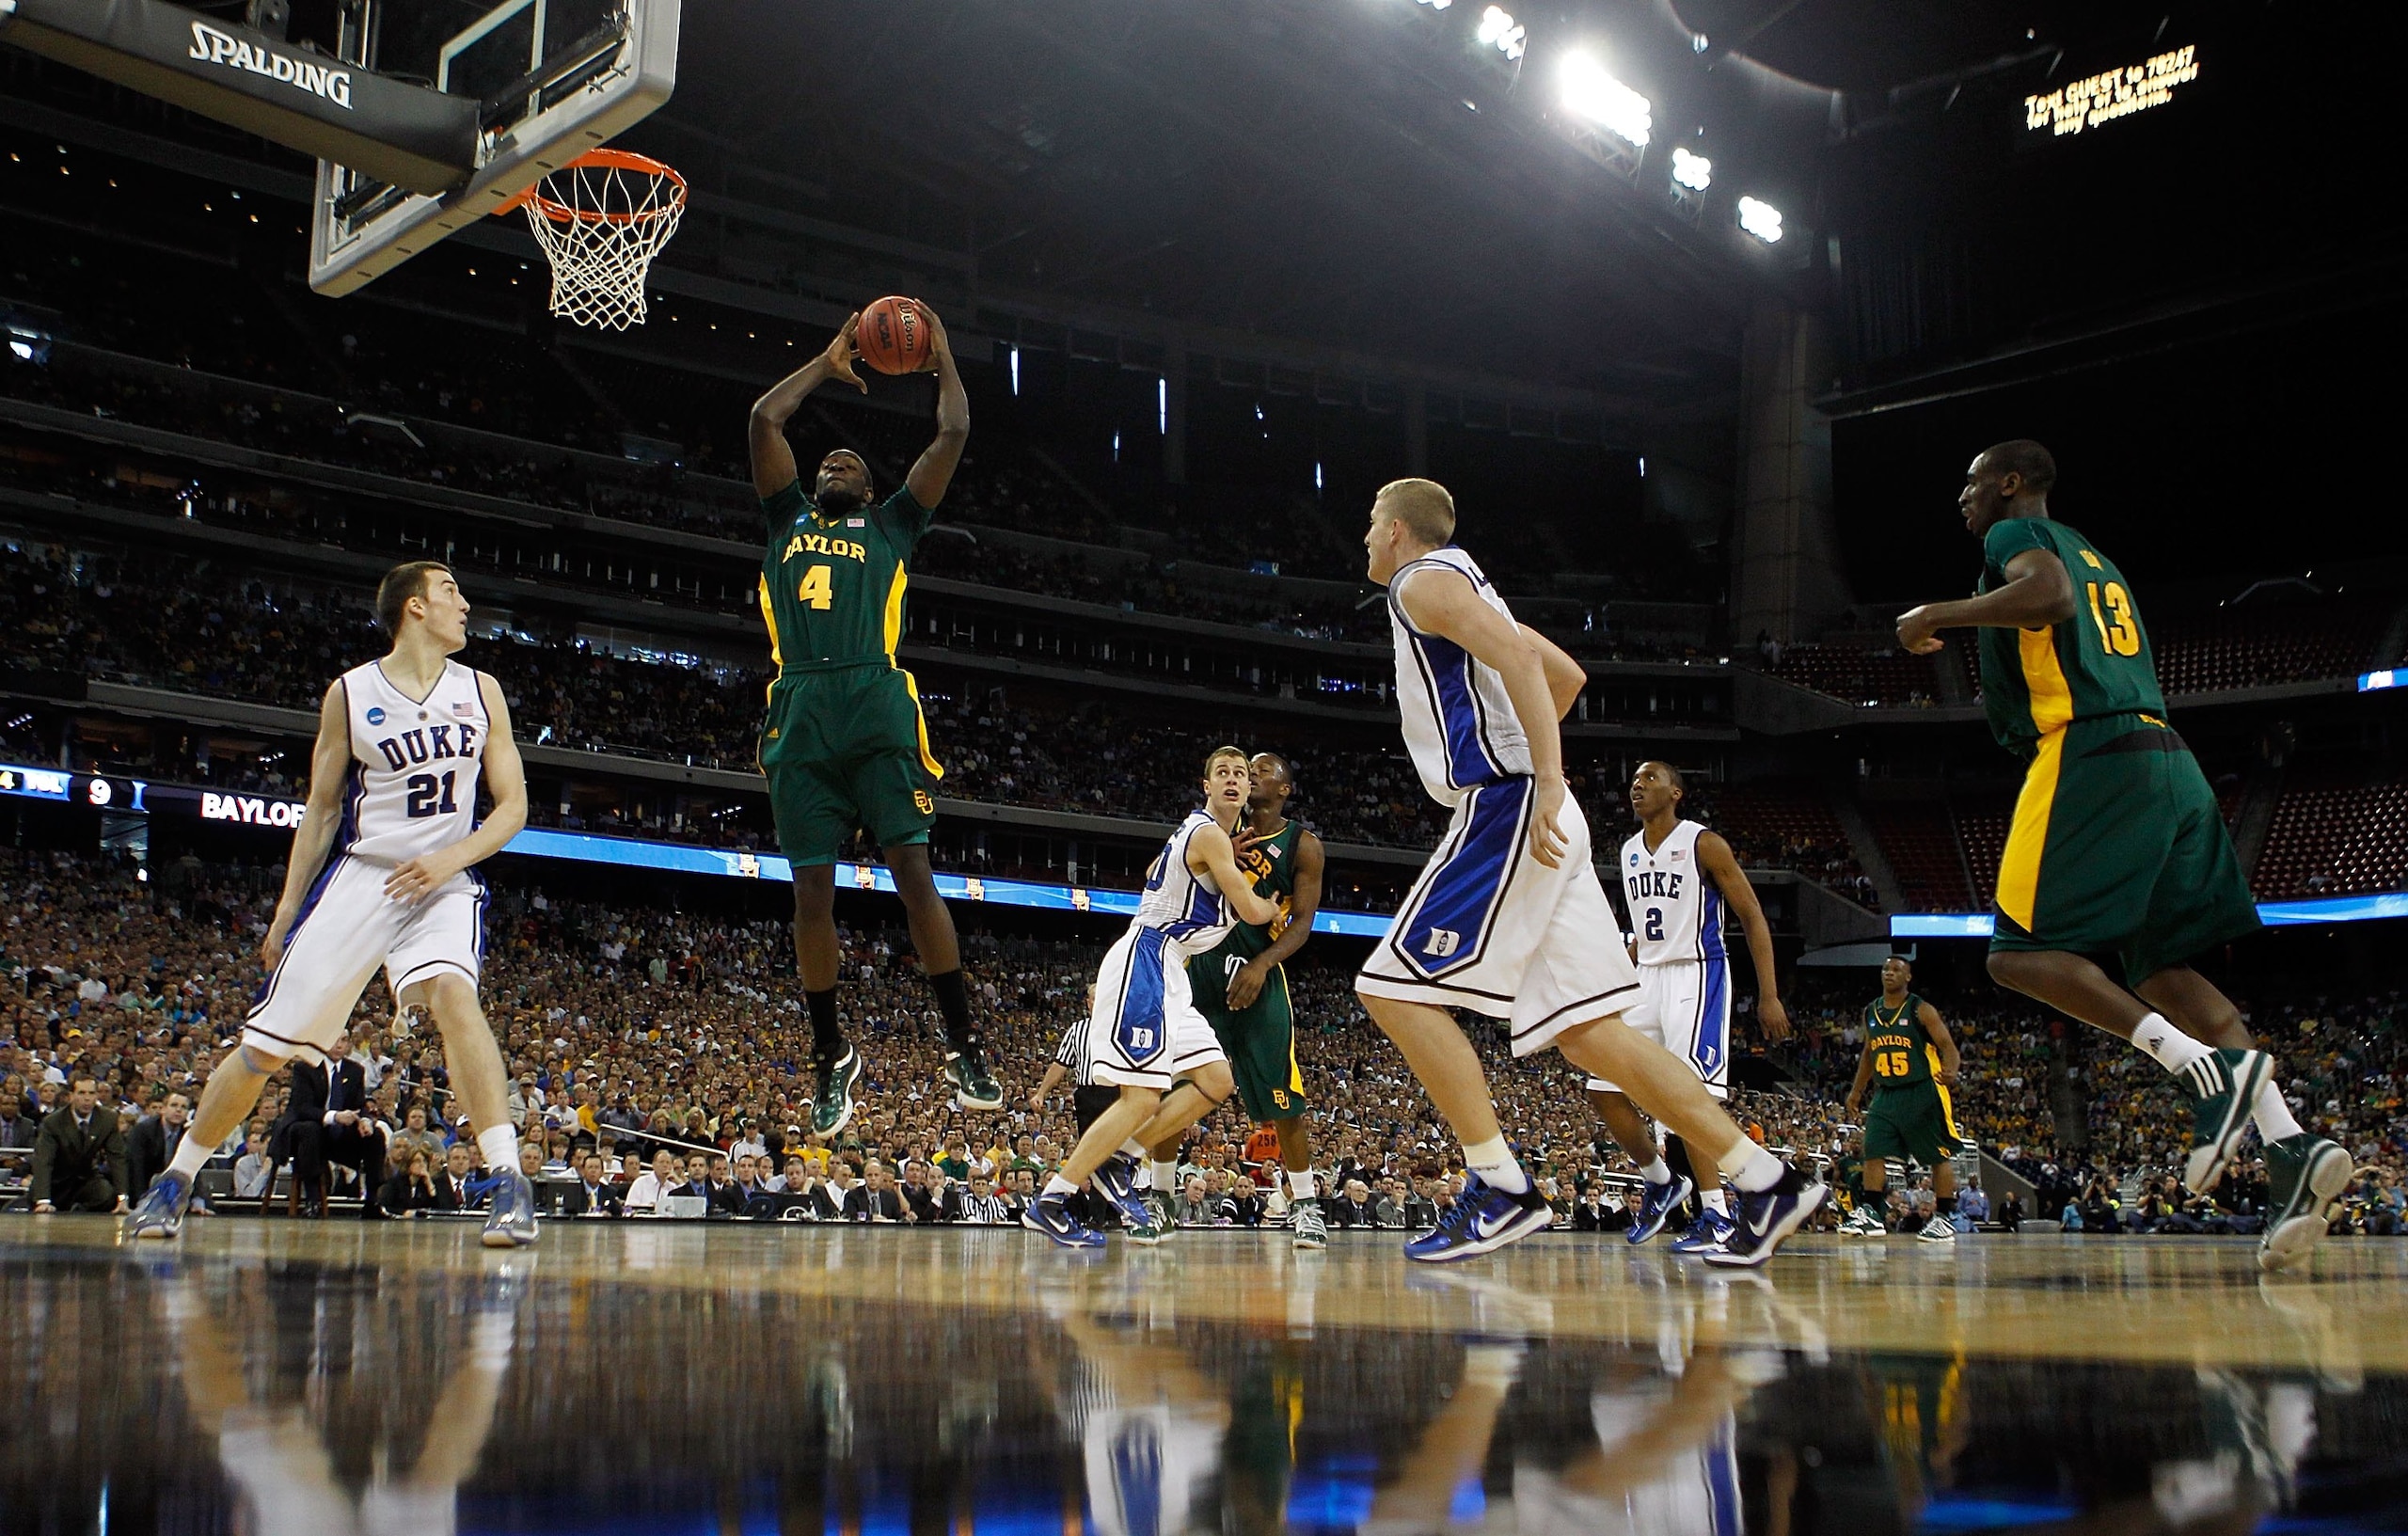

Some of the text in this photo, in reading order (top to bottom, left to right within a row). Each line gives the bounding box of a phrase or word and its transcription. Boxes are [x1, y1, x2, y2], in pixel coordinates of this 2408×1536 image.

[189, 21, 353, 110] SPALDING
[2025, 88, 2063, 113] Text
[2066, 67, 2124, 103] GUEST
[2126, 66, 2144, 85] to
[2026, 106, 2051, 131] for
[2052, 95, 2090, 123] help
[2115, 84, 2132, 103] to
[2136, 62, 2199, 96] answer
[2053, 114, 2084, 136] any
[799, 564, 832, 610] 4
[2086, 580, 2140, 657] 13
[377, 723, 477, 771] DUKE
[88, 778, 112, 805] 9
[407, 769, 458, 818] 21
[1628, 871, 1684, 902] DUKE
[1645, 908, 1665, 941] 2
[1870, 1035, 1912, 1052] BAYLOR
[1875, 1051, 1910, 1077] 45
[1258, 1133, 1276, 1148] 258
